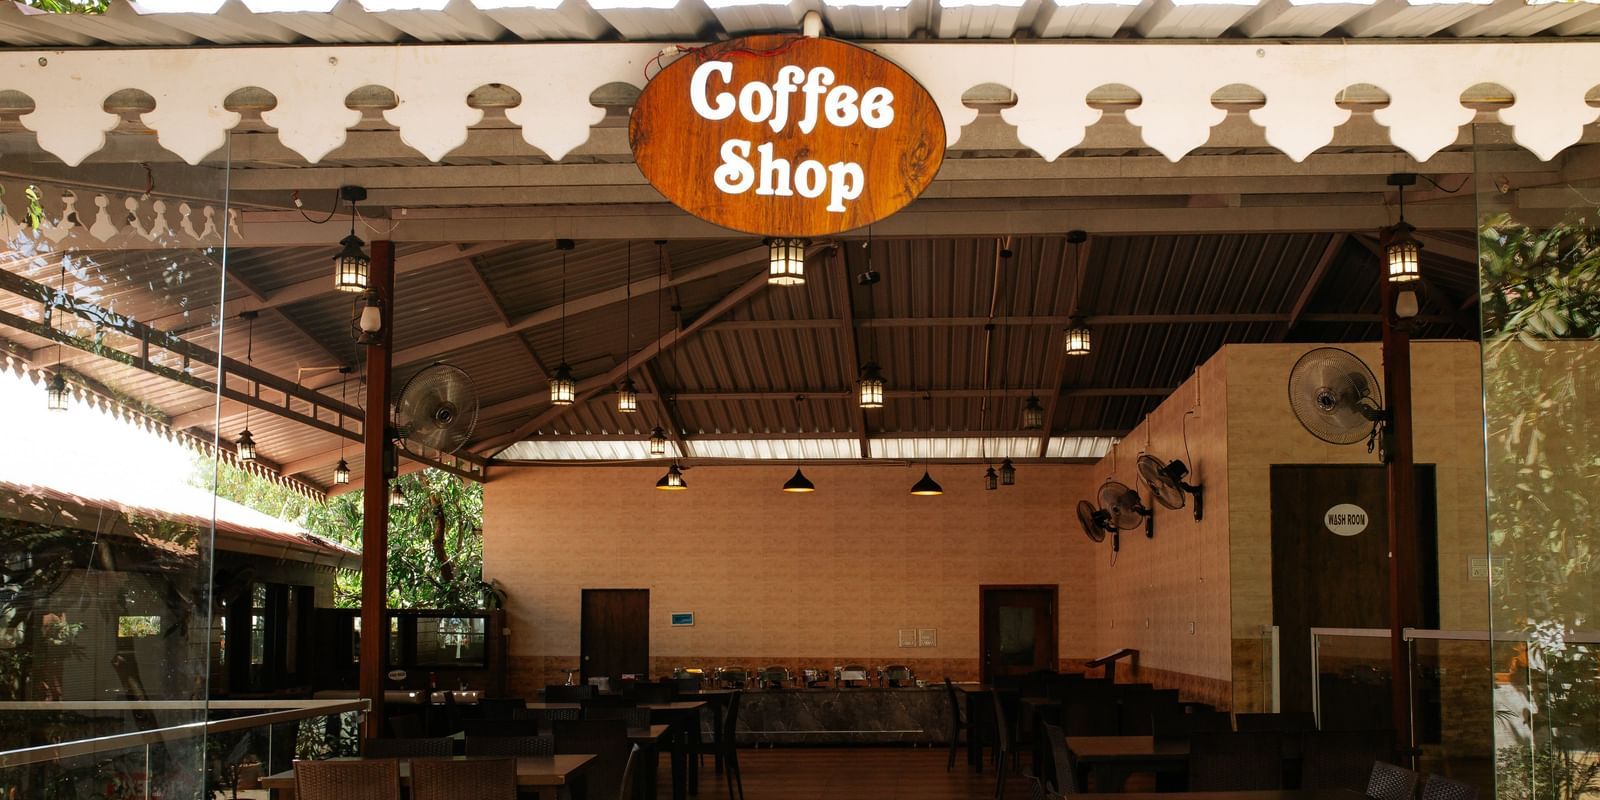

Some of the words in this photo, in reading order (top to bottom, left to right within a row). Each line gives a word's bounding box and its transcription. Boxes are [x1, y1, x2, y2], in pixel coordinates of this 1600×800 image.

[690, 60, 894, 134] Coffee
[713, 138, 865, 213] Shop
[1327, 513, 1346, 525] WASH
[1347, 513, 1365, 525] ROOM
